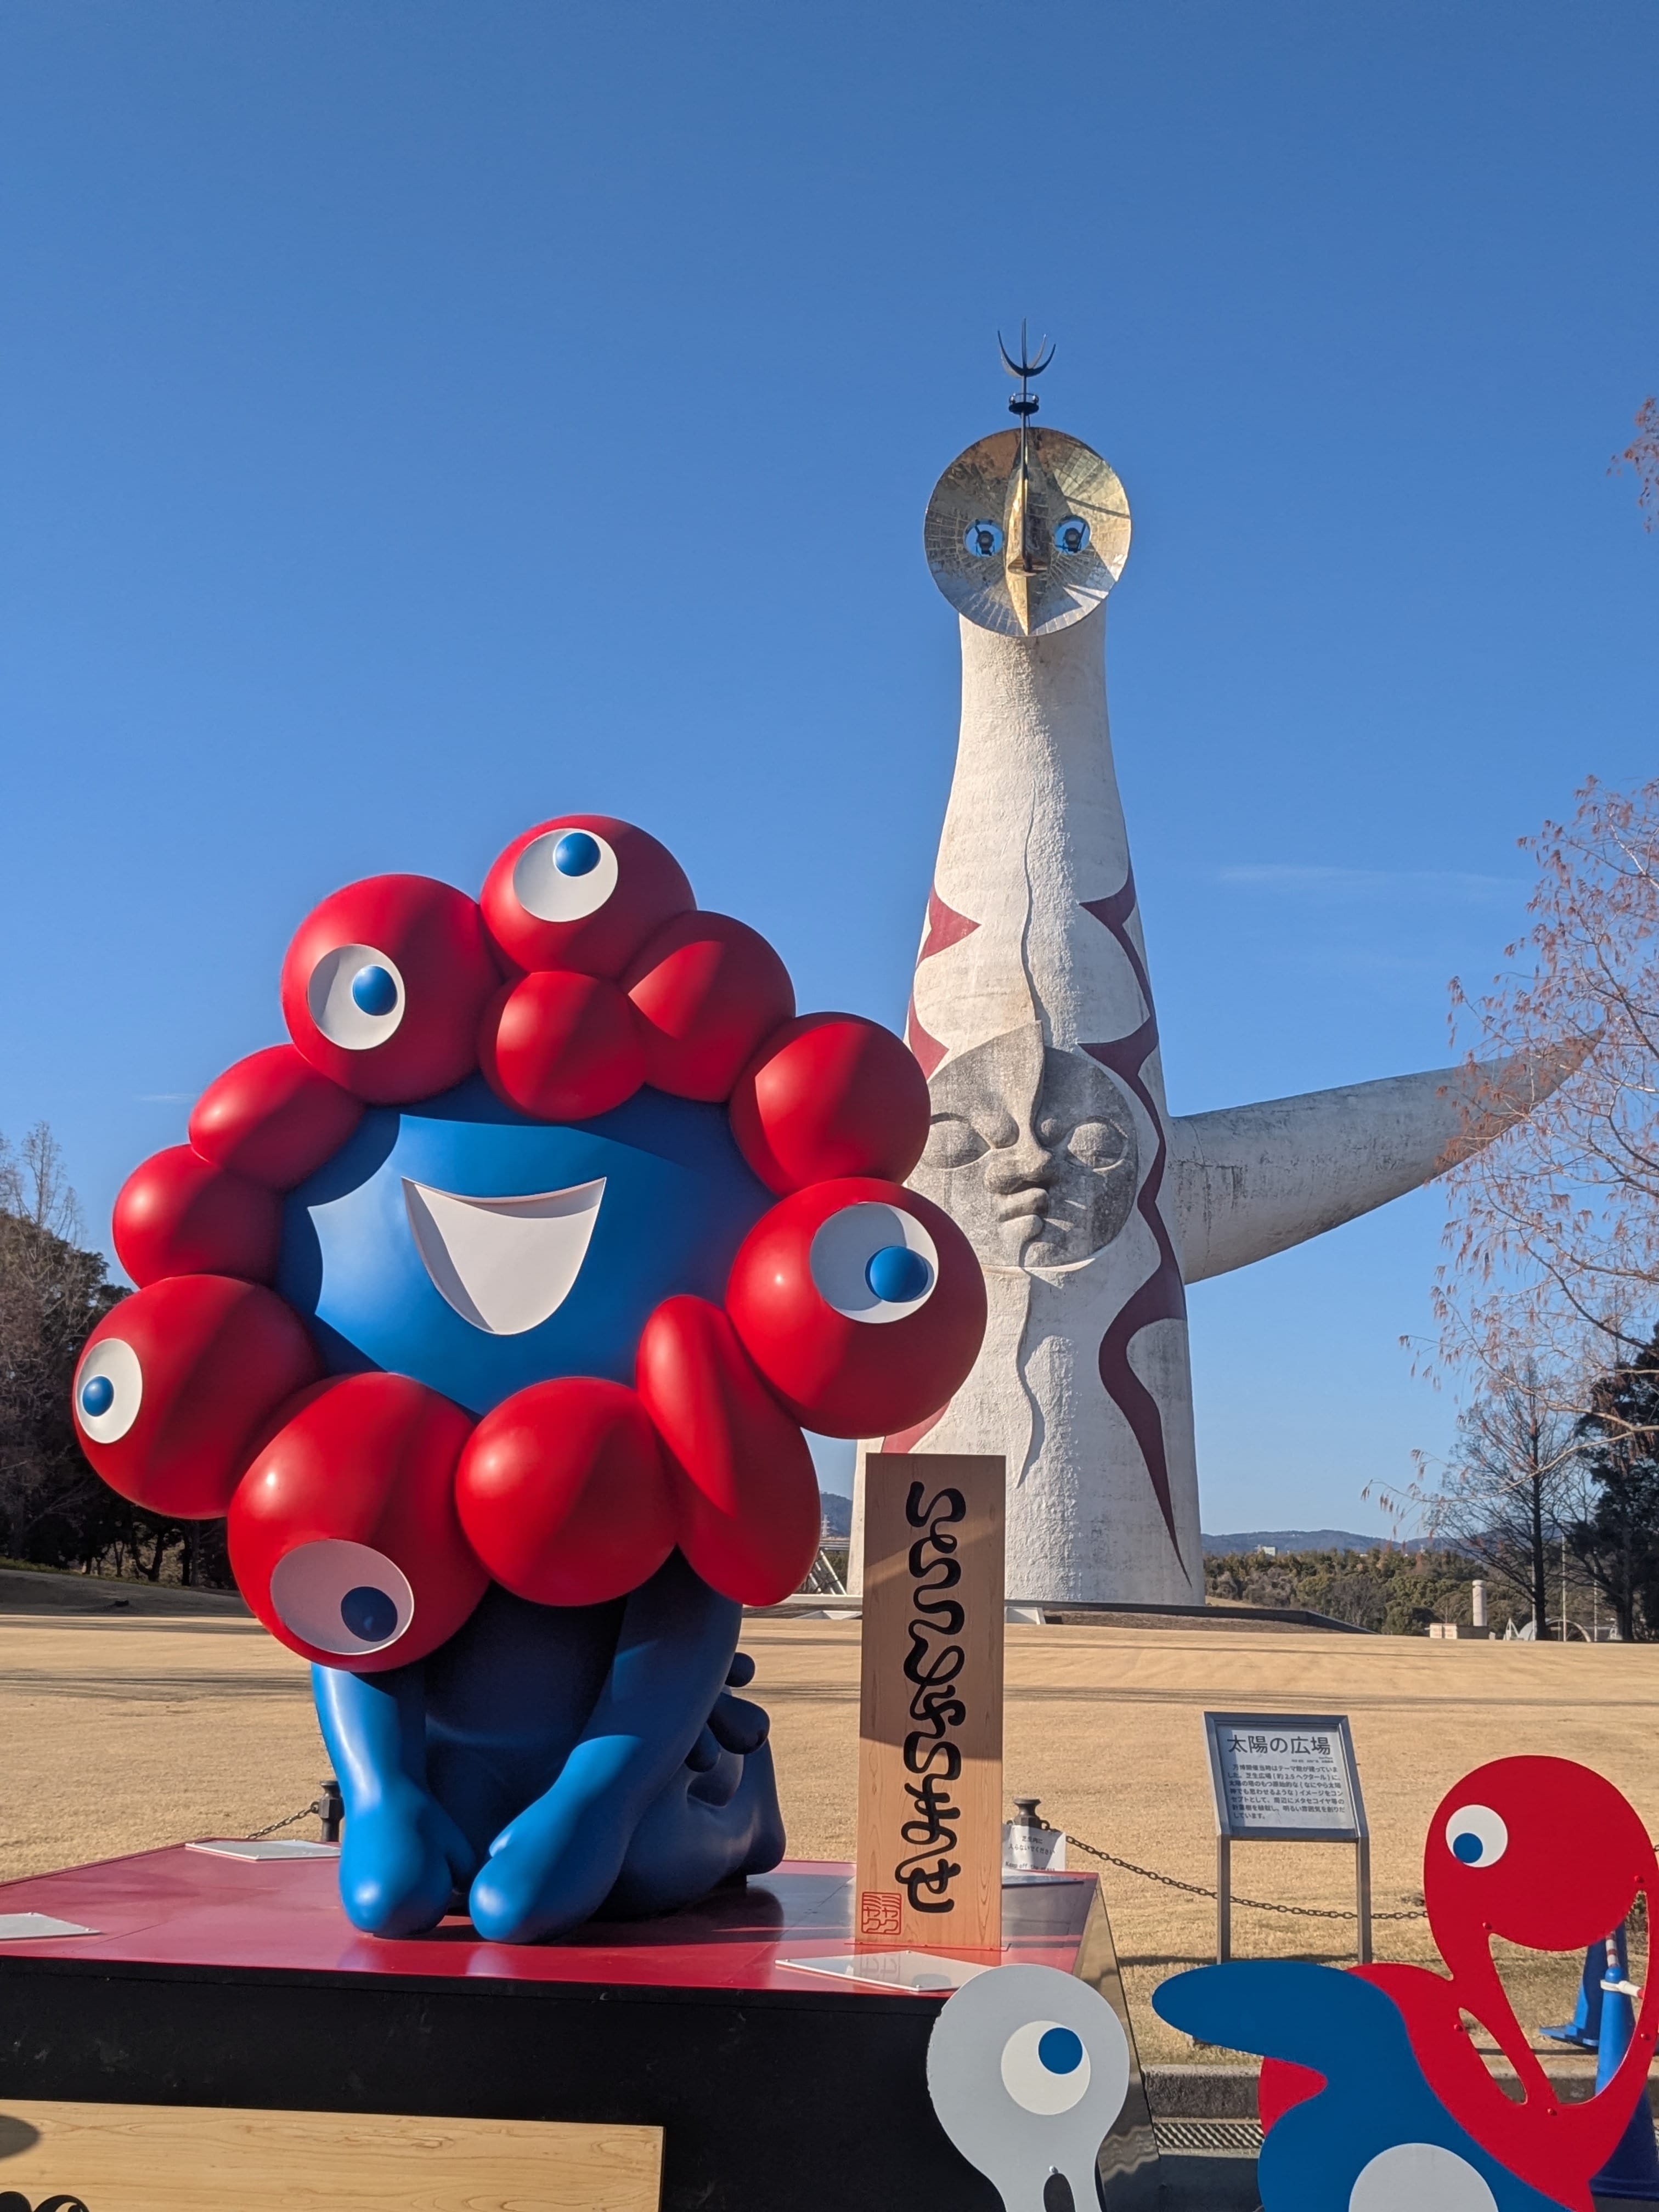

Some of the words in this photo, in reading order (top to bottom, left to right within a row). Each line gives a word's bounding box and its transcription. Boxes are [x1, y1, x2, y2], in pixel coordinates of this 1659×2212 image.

[894, 1481, 967, 1913] いらっしゃいませ
[1227, 1735, 1331, 1755] 太陽の広場
